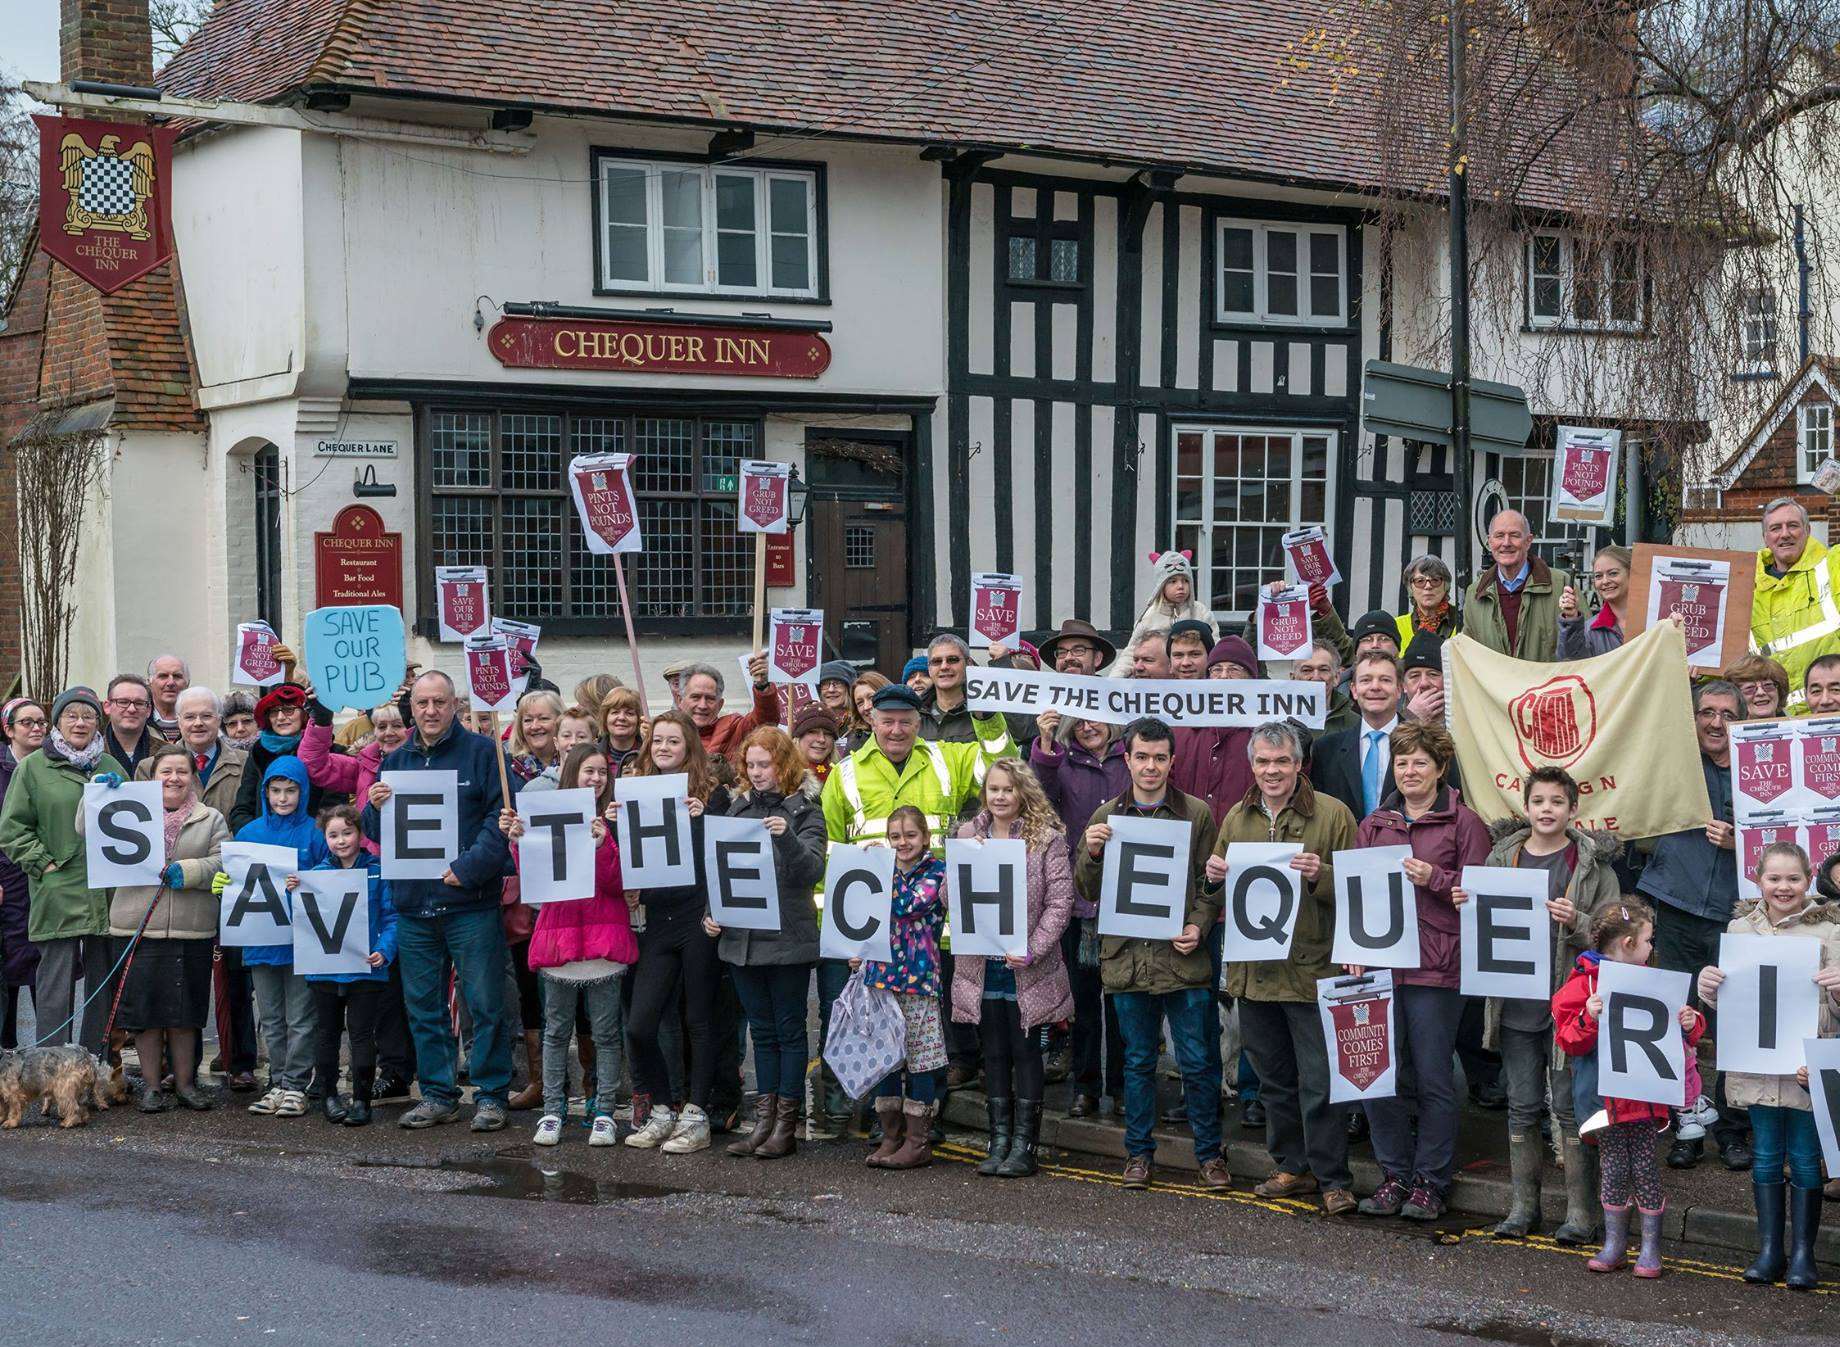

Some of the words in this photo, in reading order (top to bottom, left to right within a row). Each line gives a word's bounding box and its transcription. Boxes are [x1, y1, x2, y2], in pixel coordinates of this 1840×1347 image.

[94, 236, 120, 247] THE
[76, 245, 138, 260] CHEQUER
[95, 259, 119, 270] INN
[554, 330, 707, 364] CHEQUER
[714, 337, 771, 365] INN
[318, 441, 365, 453] CHEQUER
[366, 443, 394, 453] LANE
[1572, 462, 1600, 472] PINTS
[1574, 471, 1595, 480] NOT
[1565, 478, 1603, 488] POUNDS
[588, 490, 620, 503] PINTS
[753, 490, 776, 499] GRUB
[593, 502, 618, 514] NOT
[755, 498, 774, 506] NOT
[749, 505, 779, 514] GREED
[591, 512, 631, 526] POUNDS
[323, 538, 371, 549] CHEQUER
[374, 538, 394, 548] INN
[358, 574, 375, 582] Food
[333, 590, 369, 598] Traditional
[371, 590, 386, 598] Ales
[452, 598, 474, 606] SAVE
[1670, 603, 1706, 615] GRUB
[454, 606, 473, 614] OUR
[456, 613, 473, 621] PUB
[977, 608, 1015, 623] SAVE
[323, 610, 380, 636] SAVE
[1271, 617, 1298, 626] GRUB
[1683, 615, 1703, 626] OT
[1274, 625, 1296, 633] NOT
[1685, 627, 1709, 638] EED
[1268, 632, 1302, 642] GREED
[334, 636, 380, 658] OUR
[777, 644, 815, 658] SAVE
[245, 659, 277, 669] GREED
[252, 653, 271, 661] NOT
[325, 661, 385, 692] PUB
[475, 665, 499, 675] PINTS
[479, 674, 497, 682] NOT
[474, 682, 508, 692] POUNDS
[967, 679, 1039, 704] SAVE
[1049, 686, 1099, 711] THE
[1108, 691, 1247, 720] CHEQUER
[1257, 693, 1316, 716] INN
[1517, 692, 1580, 755] CAMRA
[1741, 763, 1788, 780] SAVE
[1815, 772, 1840, 782] FIRS
[1496, 775, 1616, 794] CAGN
[98, 800, 152, 865] S
[395, 794, 445, 859] E
[626, 798, 680, 868] H
[530, 813, 584, 881] T
[716, 841, 767, 909] E
[1116, 842, 1174, 918] E
[226, 863, 291, 926] A
[958, 864, 1013, 935] H
[832, 869, 884, 941] C
[1233, 866, 1294, 945] Q
[1347, 872, 1404, 949] U
[300, 892, 359, 954] V
[1477, 895, 1535, 975] E
[1759, 965, 1777, 1049] I
[1338, 1023, 1386, 1041] COMMUNITY
[1609, 992, 1678, 1080] R
[1343, 1038, 1383, 1054] COMES
[1349, 1052, 1380, 1068] FIRST
